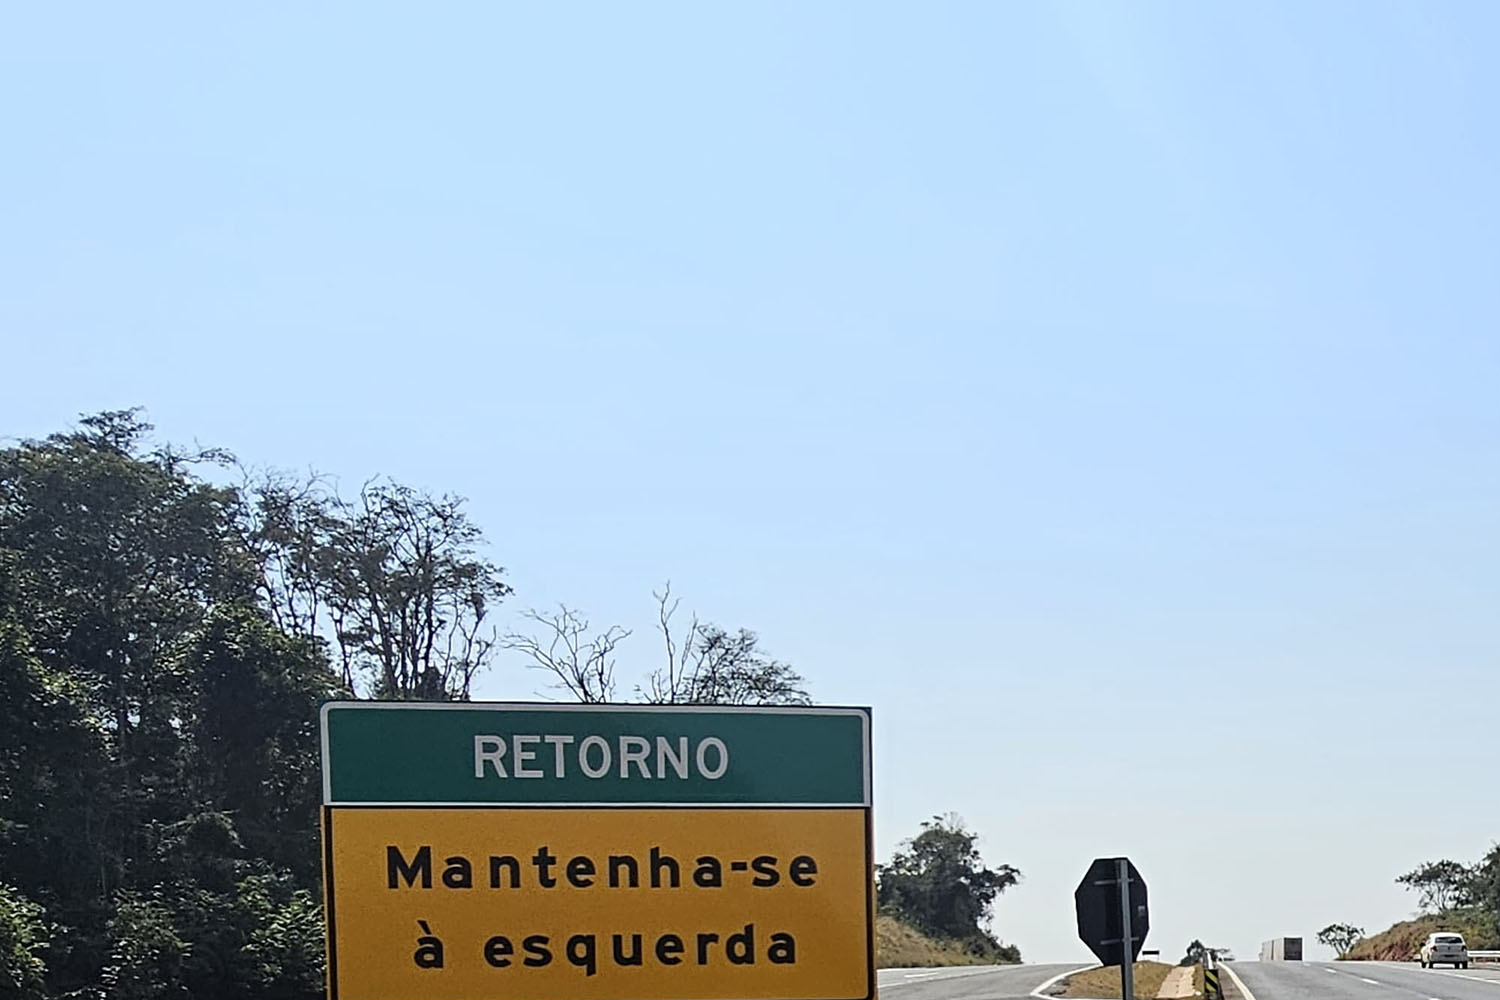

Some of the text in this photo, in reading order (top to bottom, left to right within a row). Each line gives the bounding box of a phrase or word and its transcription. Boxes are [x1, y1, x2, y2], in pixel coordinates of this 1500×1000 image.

[473, 734, 729, 780] RETORNO
[386, 844, 819, 890] Mantenha-se
[413, 920, 796, 977] à esquerda
